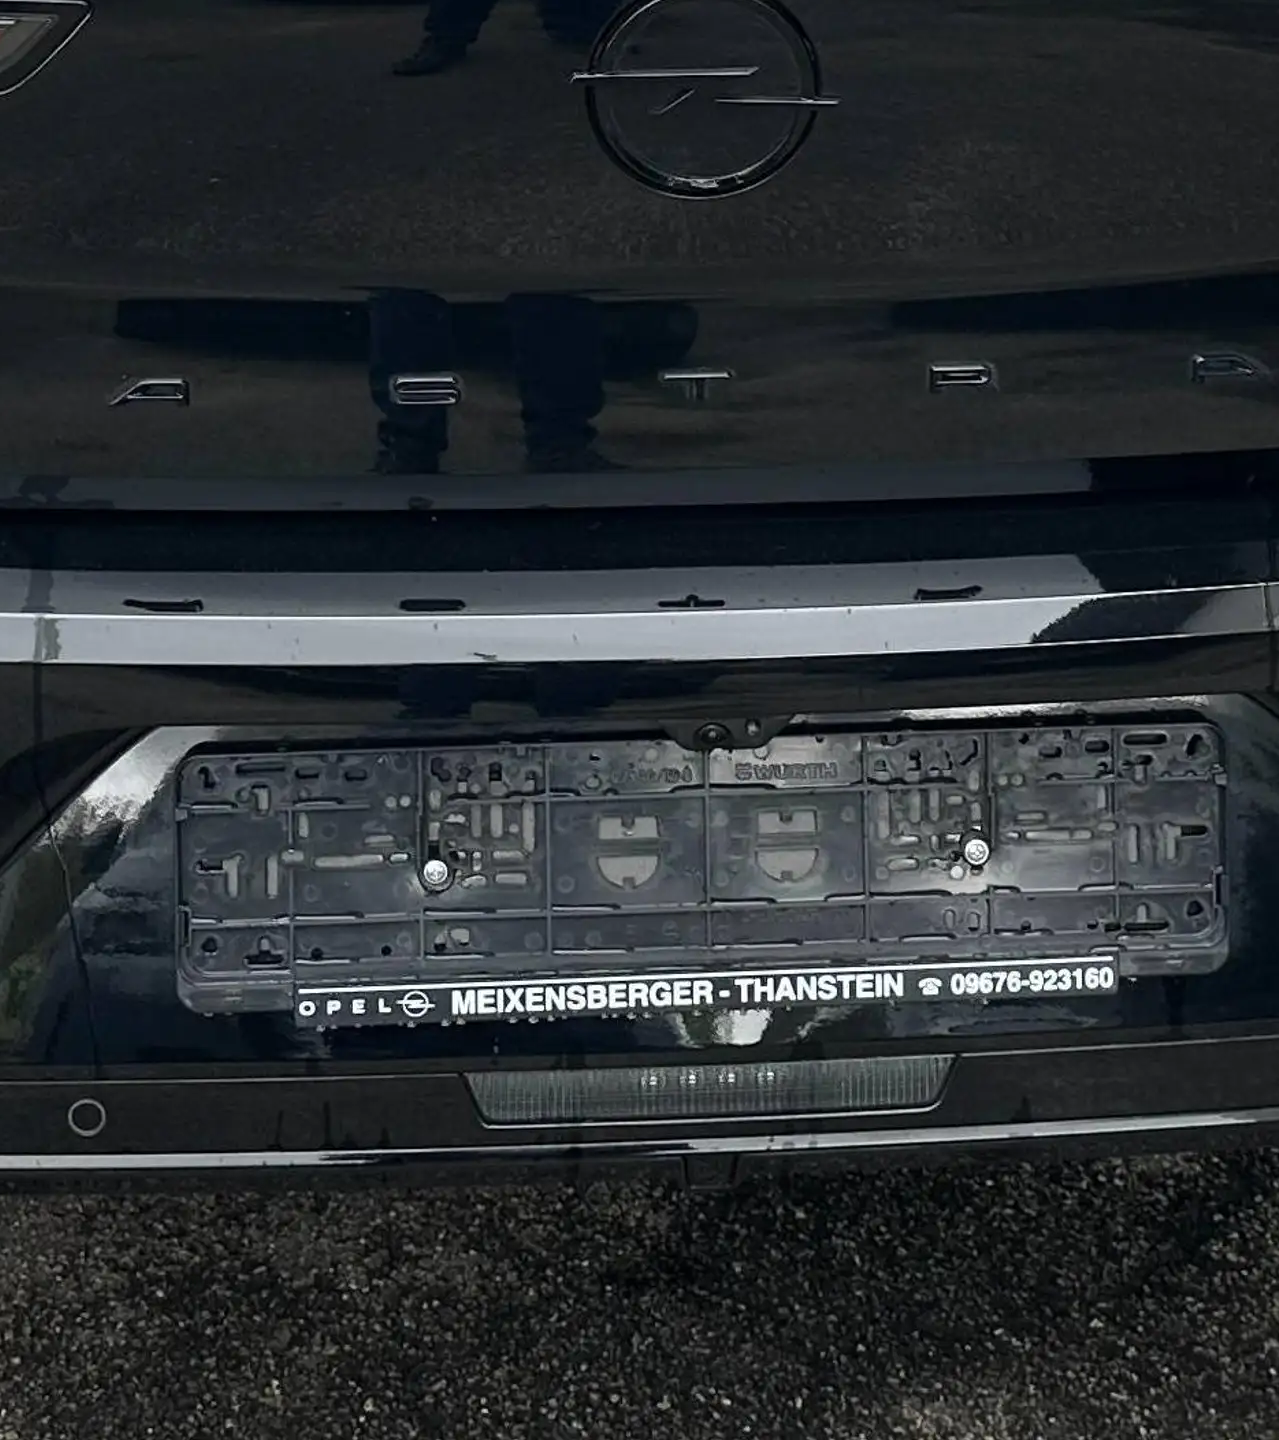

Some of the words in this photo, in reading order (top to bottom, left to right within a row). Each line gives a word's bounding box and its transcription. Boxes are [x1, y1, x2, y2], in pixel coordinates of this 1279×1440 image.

[108, 350, 1272, 408] ASTRA
[298, 996, 392, 1017] OPEL
[451, 980, 714, 1016] MEIXENSBERGER
[737, 972, 905, 1003] THANSTEIN
[950, 966, 1115, 997] 09676-923160
